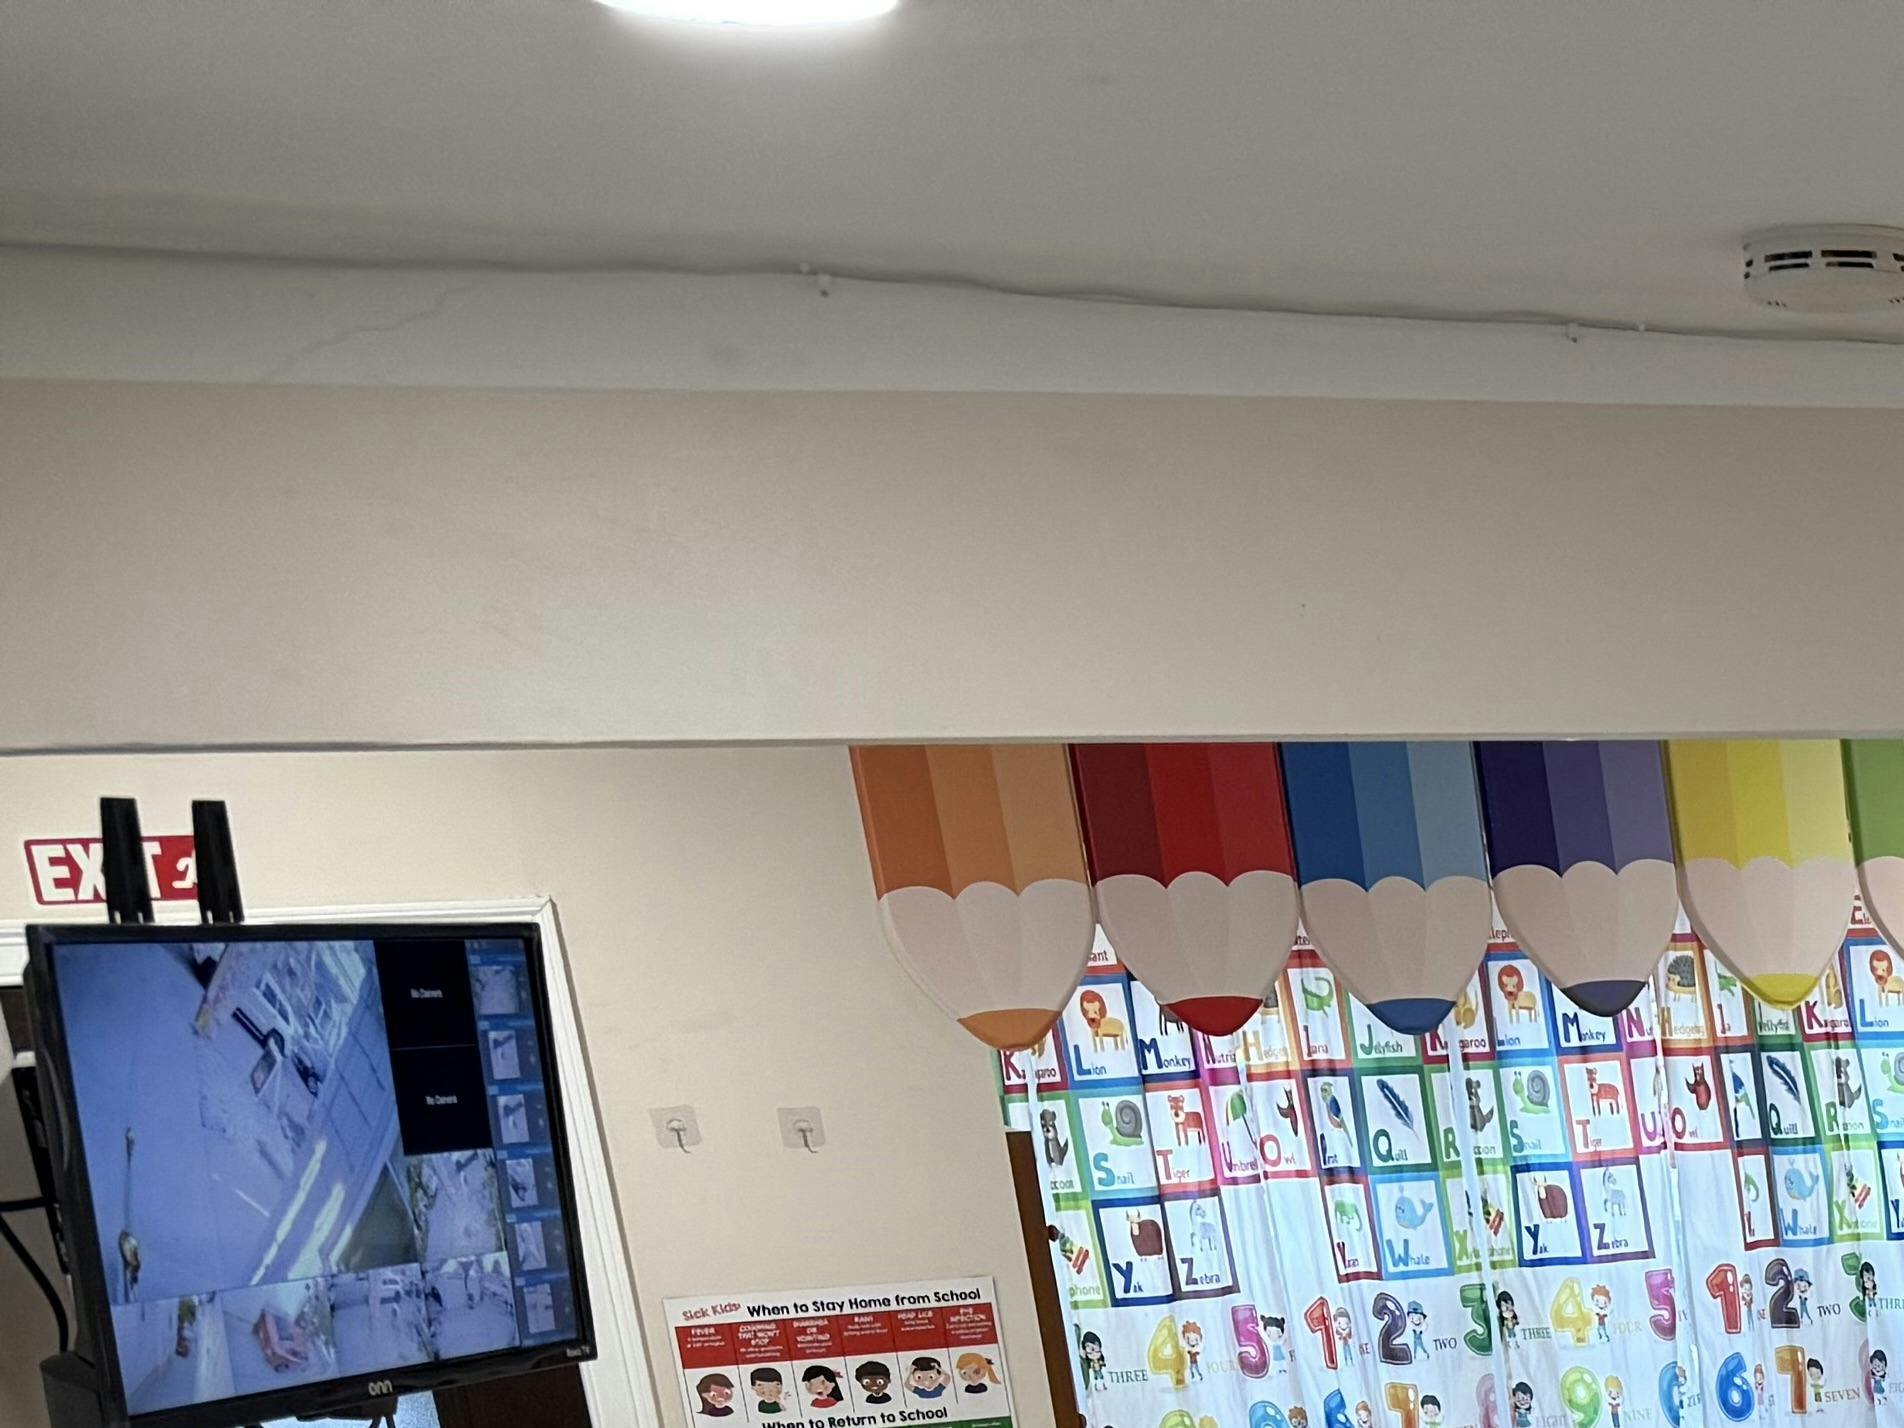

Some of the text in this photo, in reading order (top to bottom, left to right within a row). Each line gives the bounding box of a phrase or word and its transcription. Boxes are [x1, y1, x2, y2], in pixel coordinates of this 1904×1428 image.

[30, 841, 162, 900] EXT
[1138, 1038, 1191, 1071] Monkey
[682, 1288, 981, 1321] Sick When to Stay Home from School
[1817, 1303, 1841, 1316] TWO
[1433, 1337, 1457, 1352] TWO
[1108, 1370, 1148, 1383] THREE
[1824, 1388, 1860, 1403] SEVEN
[828, 1415, 877, 1428] Return
[881, 1412, 896, 1424] to
[900, 1407, 948, 1422] School
